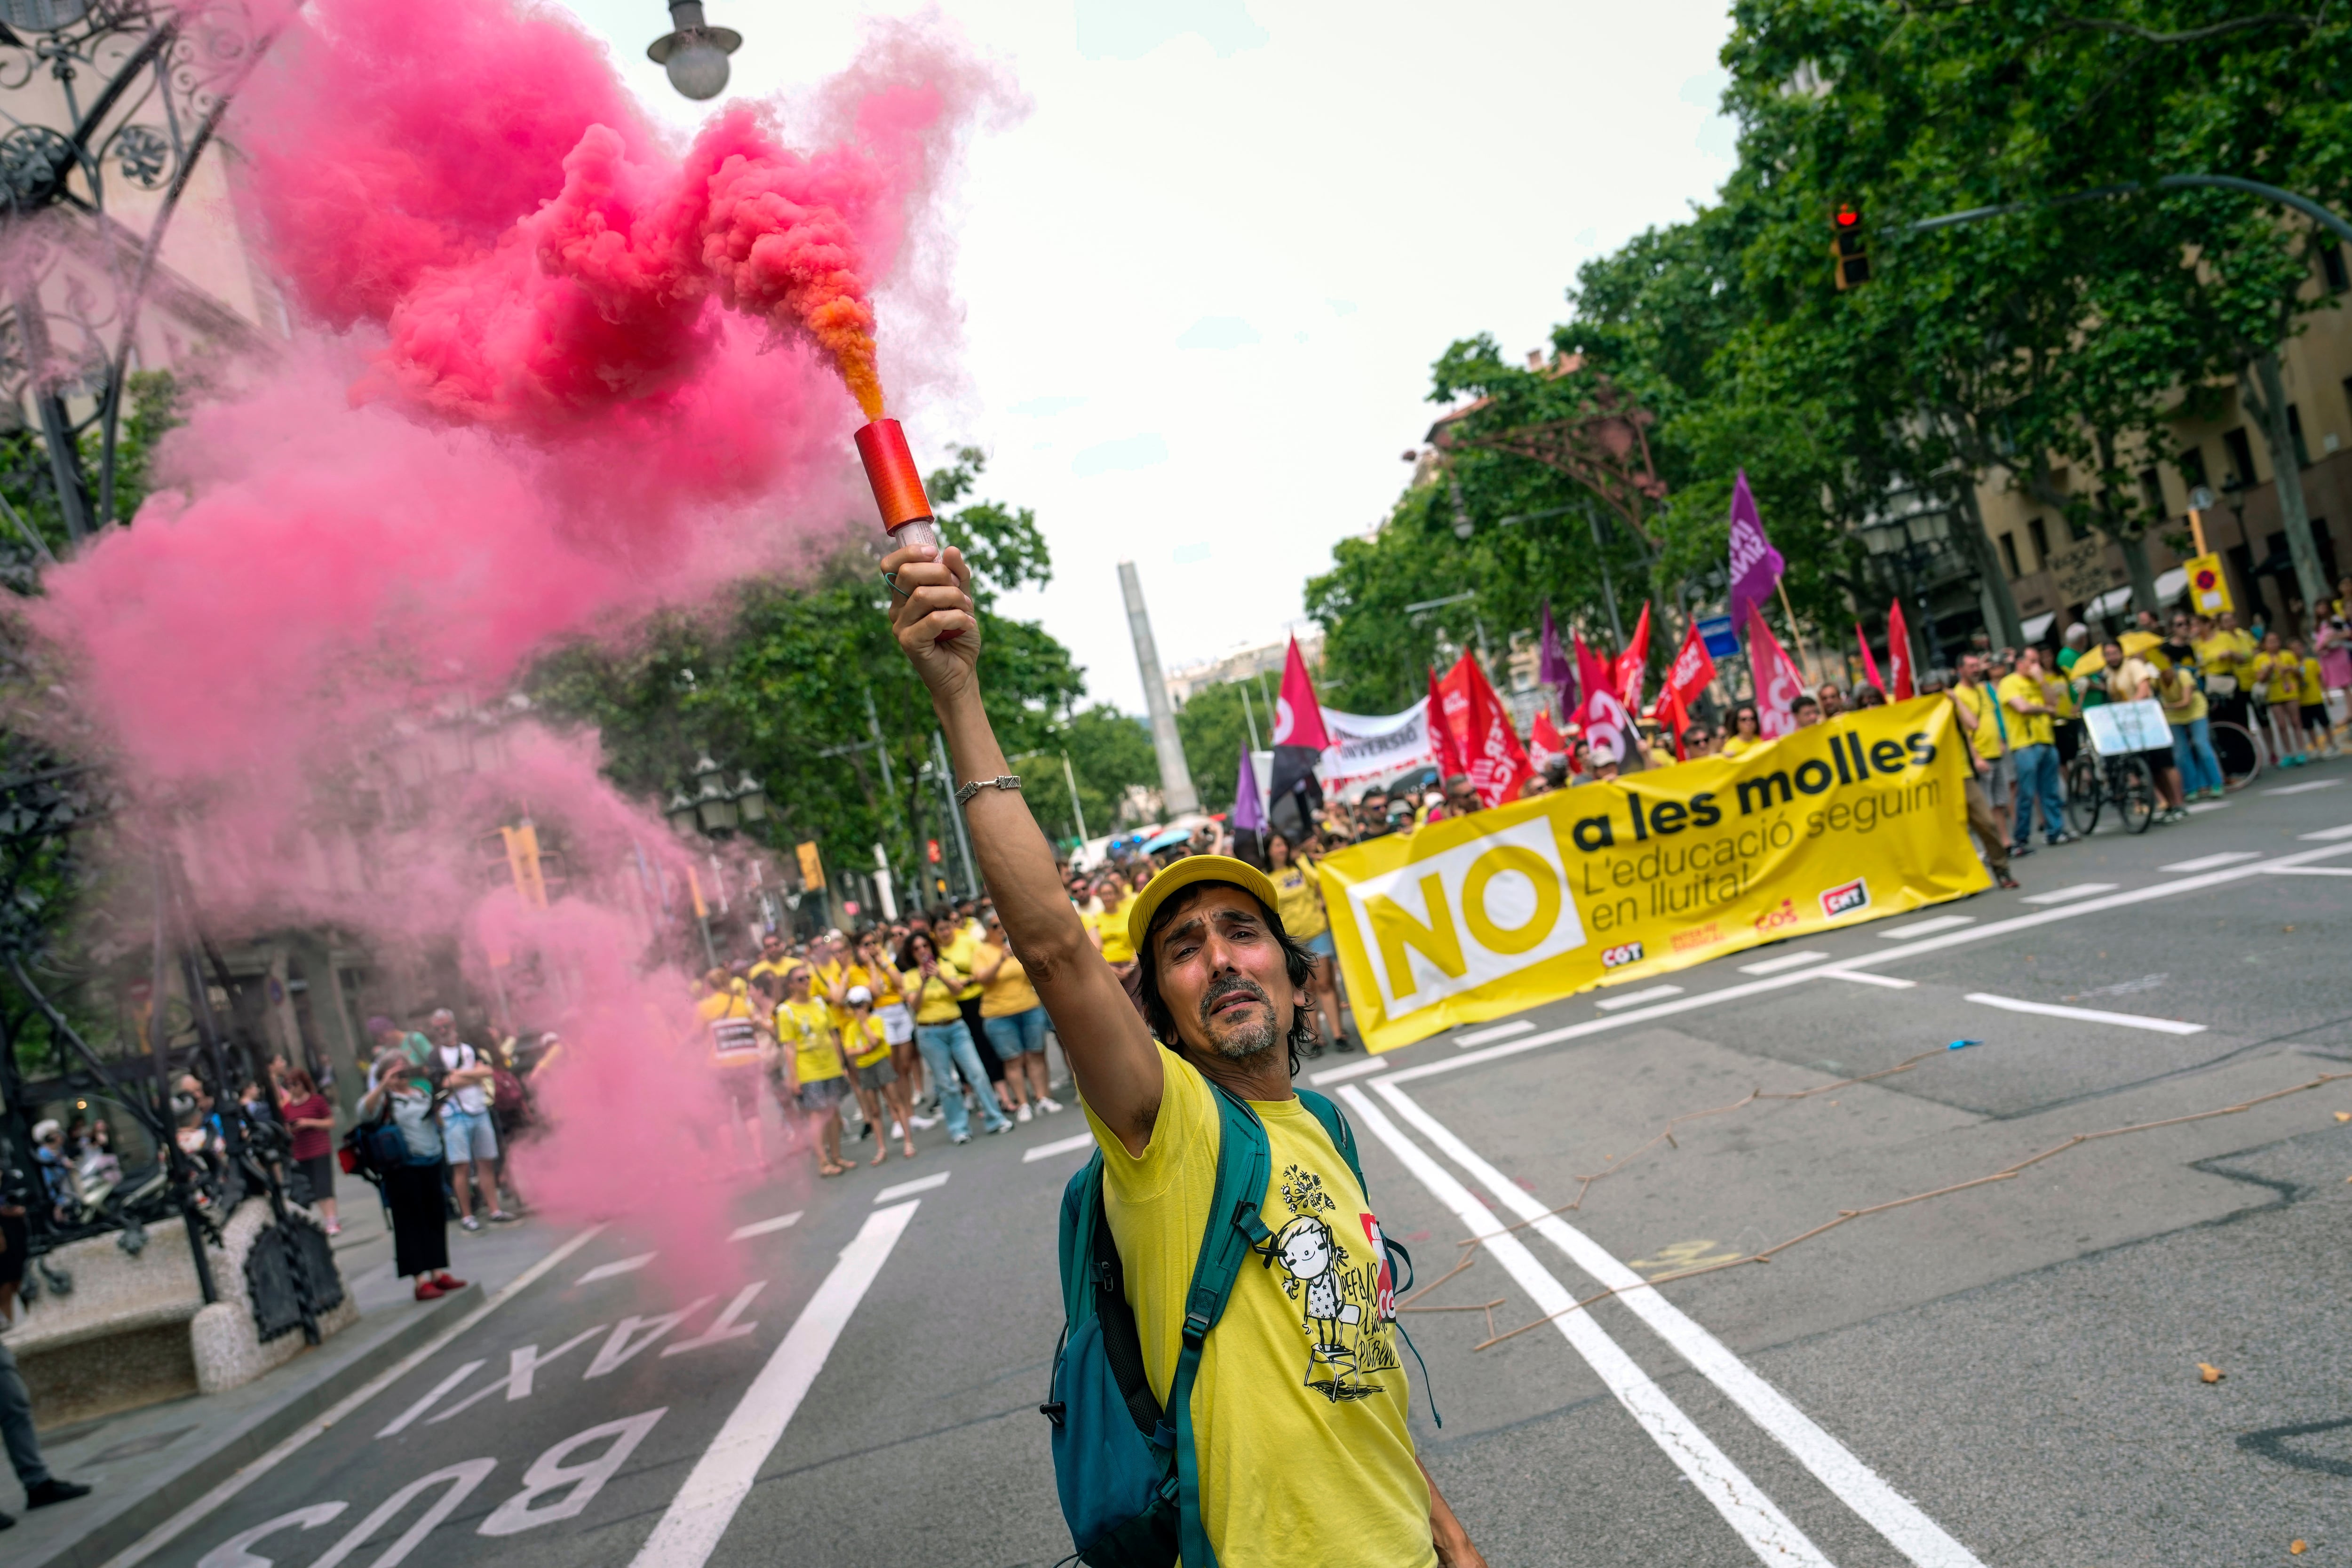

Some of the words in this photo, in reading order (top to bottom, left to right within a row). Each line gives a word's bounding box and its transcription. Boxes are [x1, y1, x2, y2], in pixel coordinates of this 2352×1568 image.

[1573, 815, 1613, 852] a
[1628, 791, 1722, 841] les
[1736, 732, 1937, 814] molles
[1583, 816, 1795, 896] L'educació
[1806, 779, 1941, 841] seguim
[1362, 844, 1561, 1001] NO
[1591, 897, 1638, 932] en
[1601, 943, 1642, 968] CGT
[374, 1280, 768, 1440] TAXI
